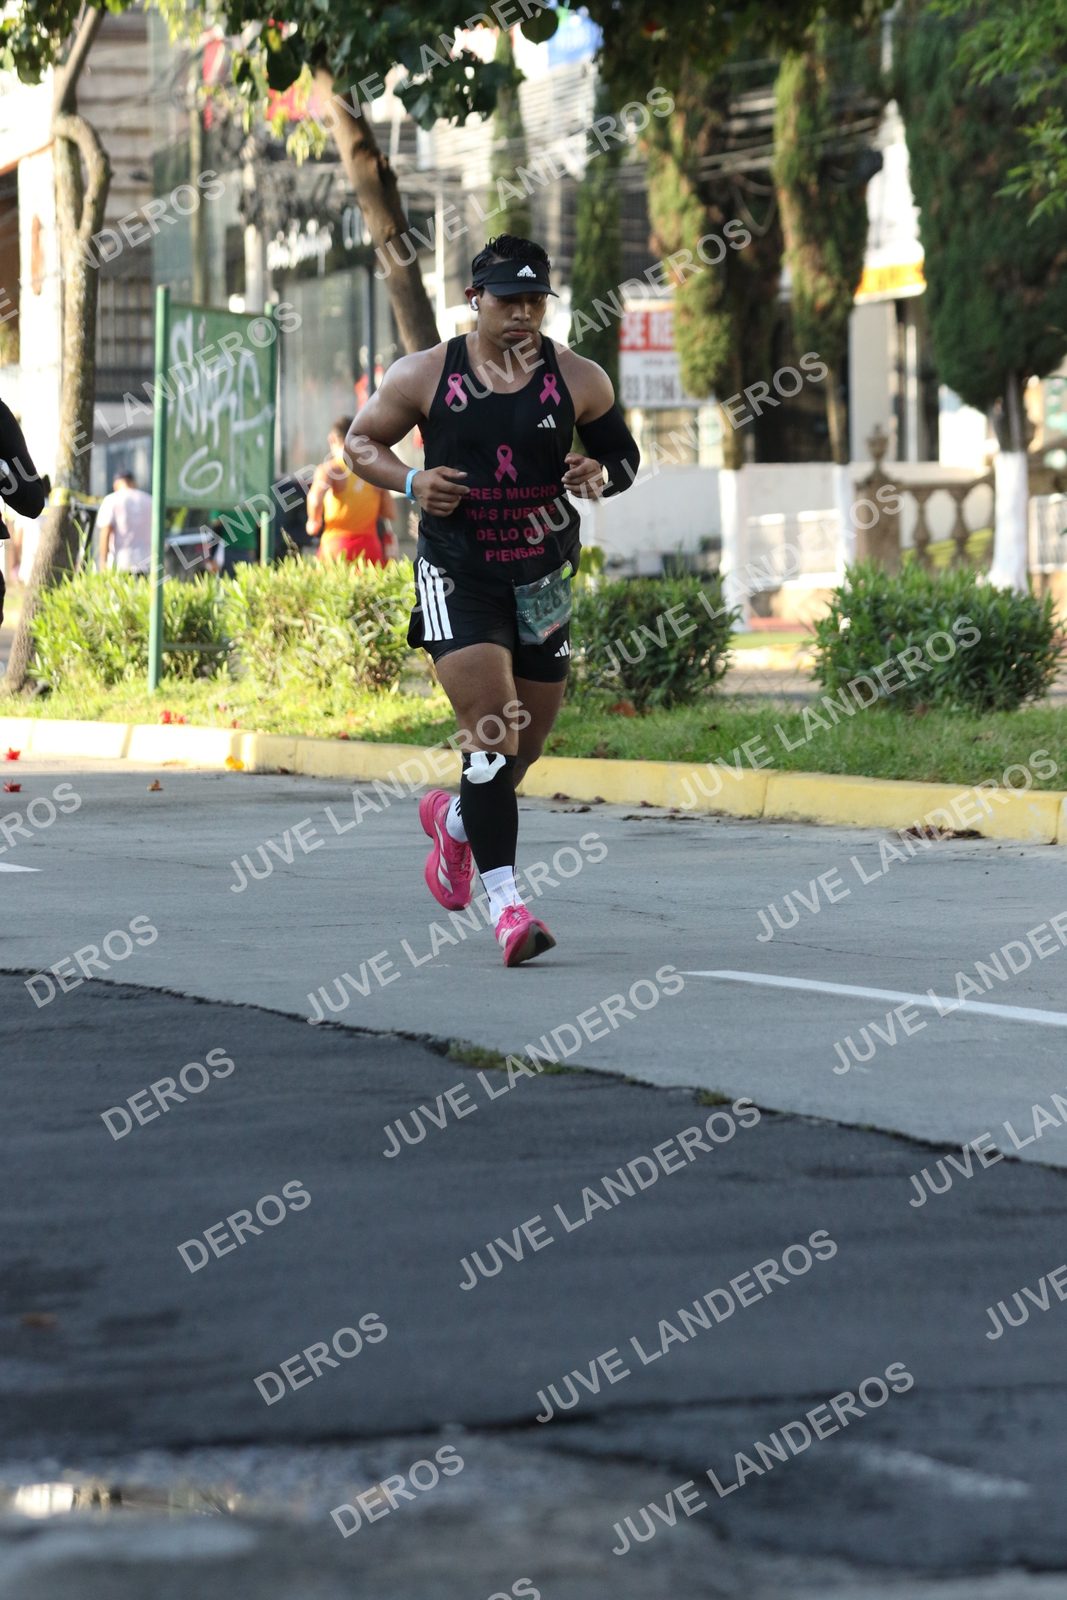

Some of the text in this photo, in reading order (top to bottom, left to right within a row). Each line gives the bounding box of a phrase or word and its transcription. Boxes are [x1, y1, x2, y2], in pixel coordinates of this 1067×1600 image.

[462, 484, 559, 501] RES MUCHO
[476, 528, 497, 541] DE
[500, 528, 519, 541] LO
[484, 544, 545, 562] PIENSAS
